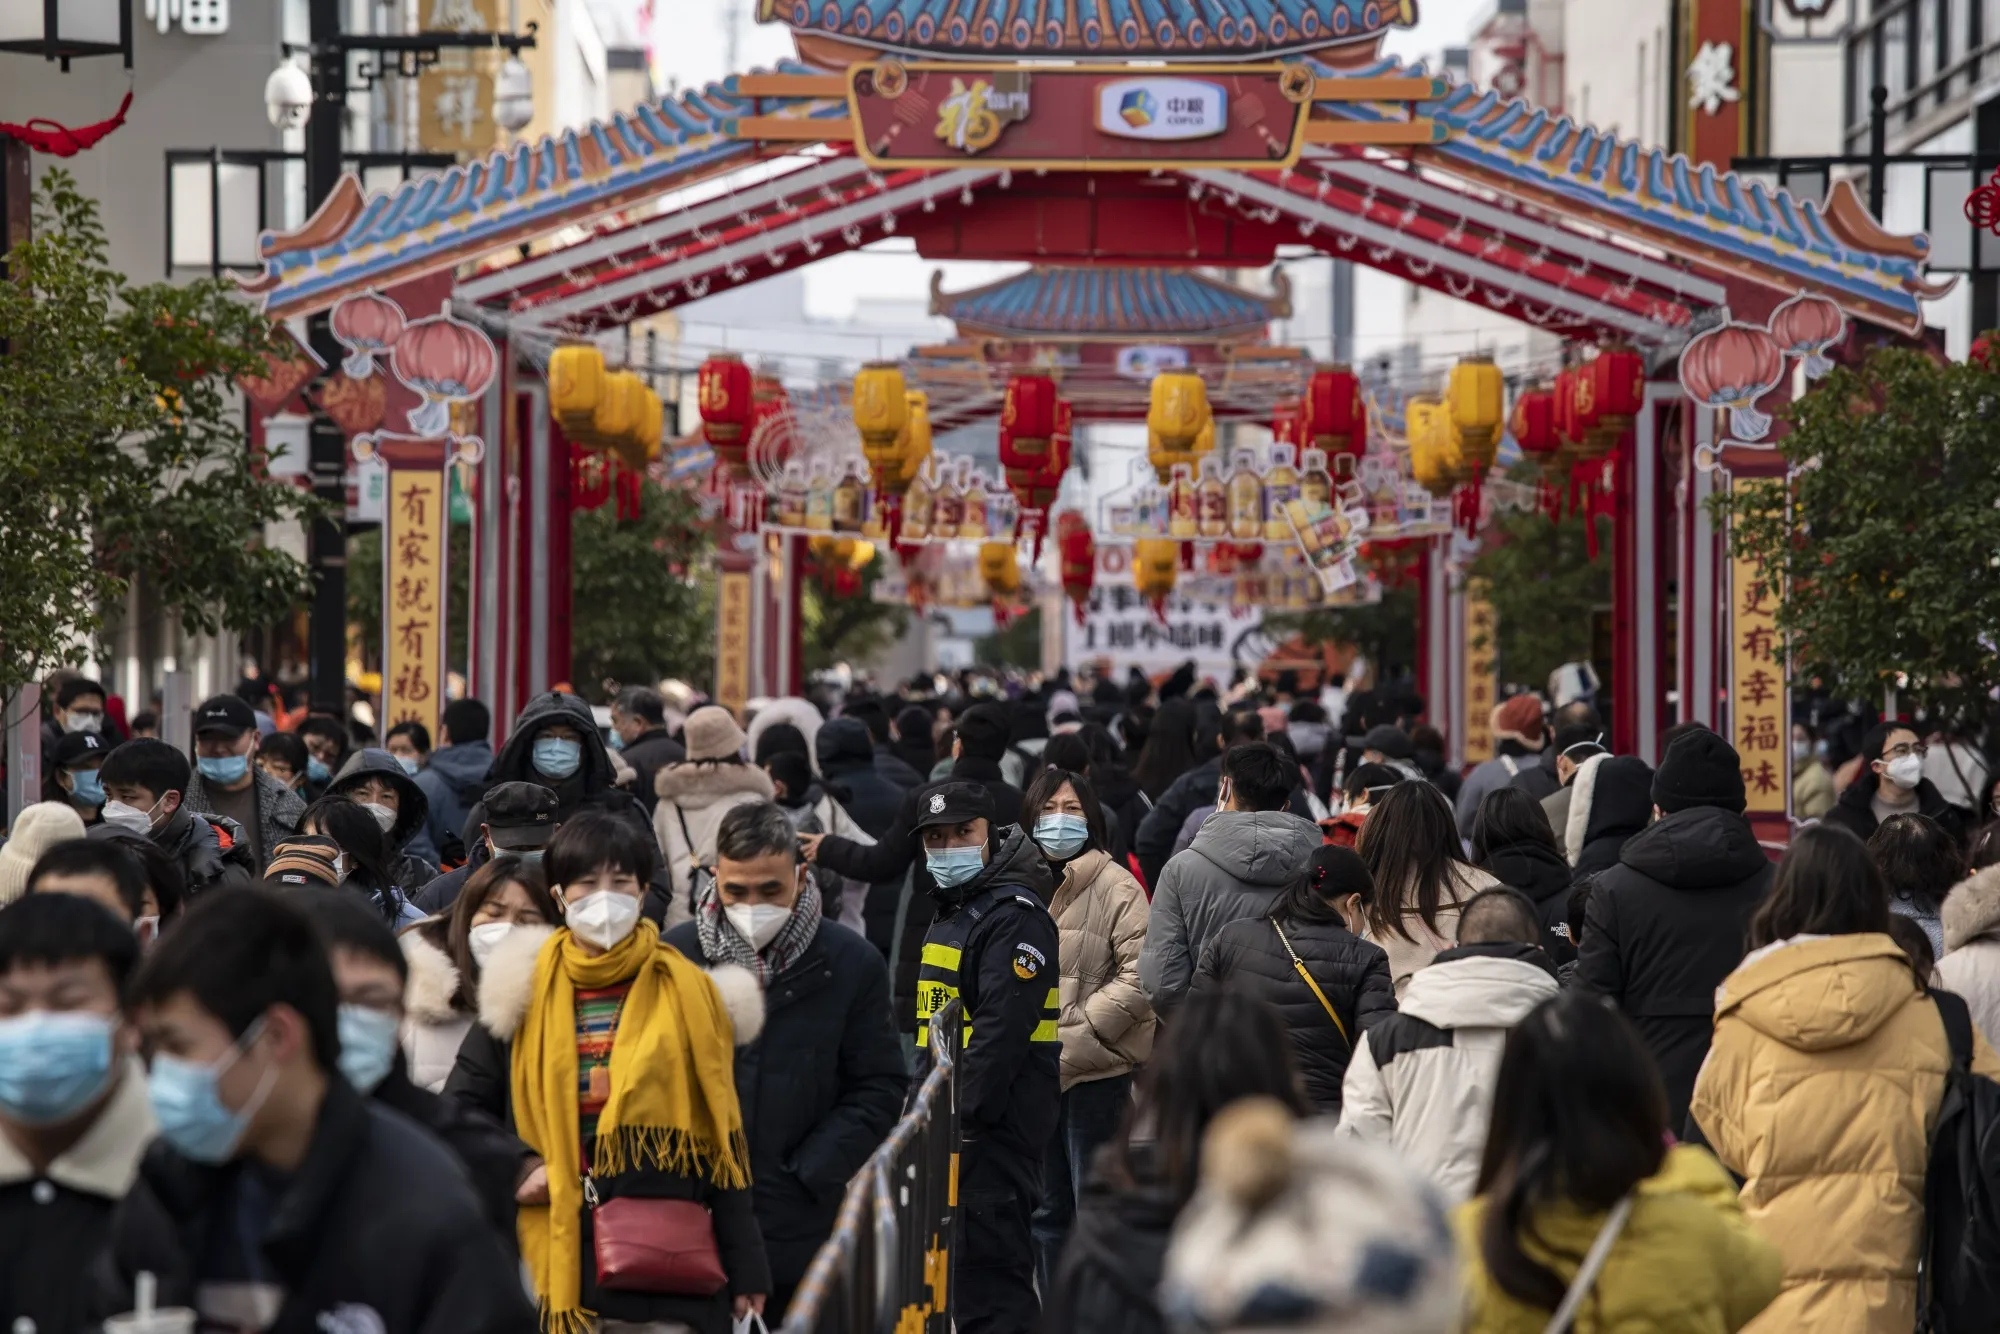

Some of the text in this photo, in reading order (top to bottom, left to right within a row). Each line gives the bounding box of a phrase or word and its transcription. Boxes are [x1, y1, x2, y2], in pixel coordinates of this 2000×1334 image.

[1167, 116, 1204, 125] COFCO
[1739, 548, 1780, 796] 更有幸福味
[84, 736, 98, 748] R
[917, 990, 928, 1011] IN
